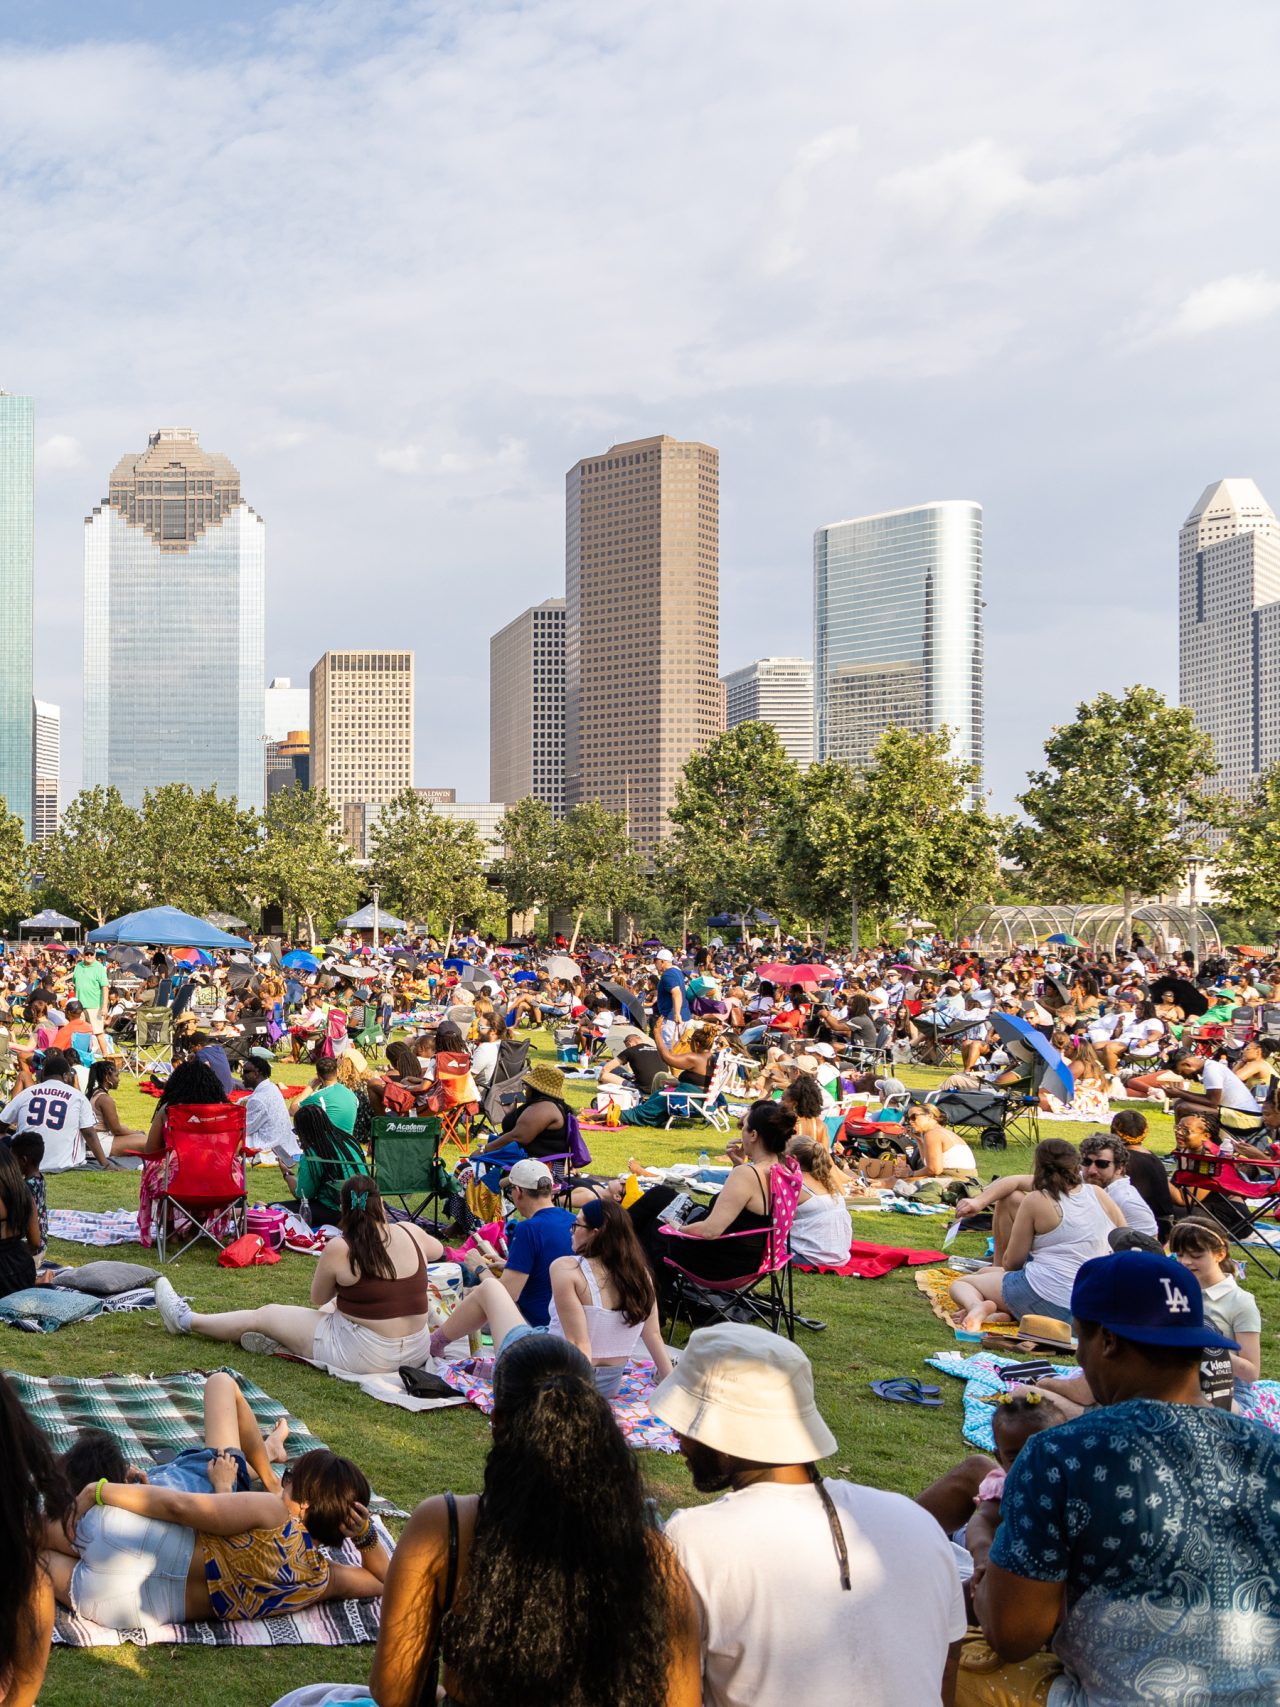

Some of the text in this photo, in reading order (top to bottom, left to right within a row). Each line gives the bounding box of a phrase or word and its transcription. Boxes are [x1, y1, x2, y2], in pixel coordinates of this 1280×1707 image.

[31, 1088, 72, 1100] VAUGHN
[26, 1097, 68, 1131] 99
[396, 1122, 428, 1132] Academy
[1159, 1277, 1191, 1313] LA
